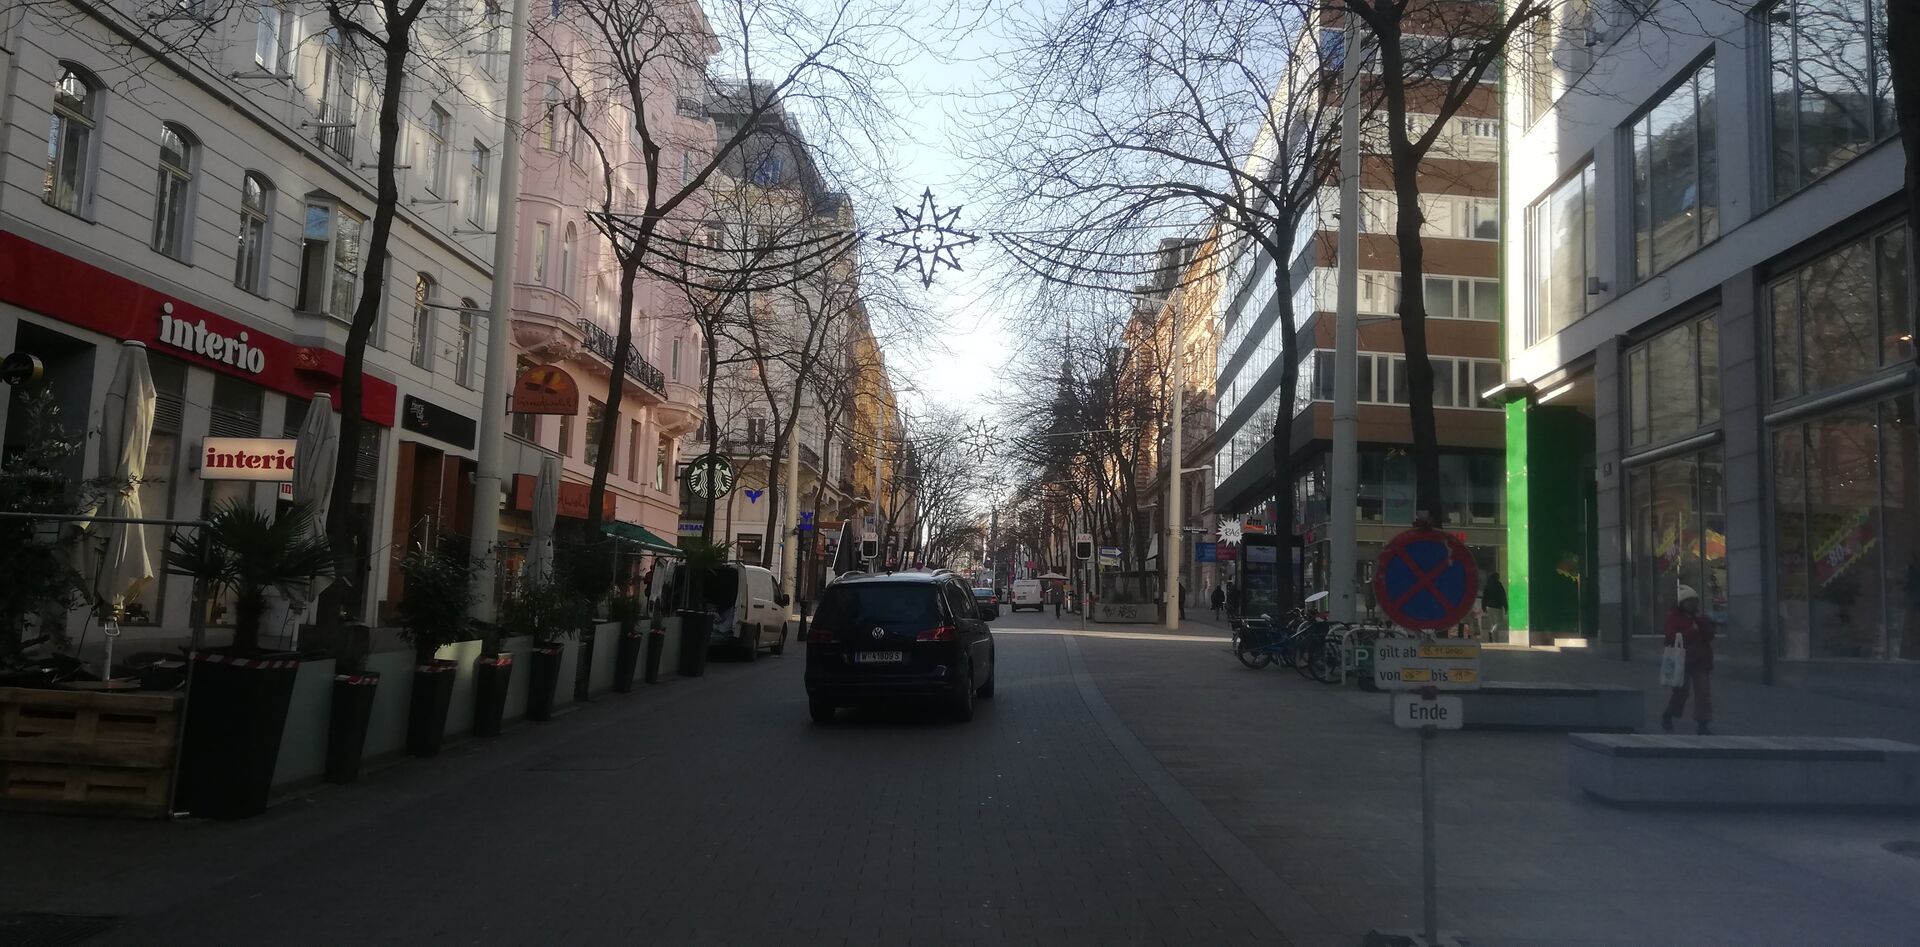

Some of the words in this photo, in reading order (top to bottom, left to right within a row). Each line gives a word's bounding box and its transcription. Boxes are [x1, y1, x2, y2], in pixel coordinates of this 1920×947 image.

[159, 302, 265, 374] interio
[1246, 516, 1263, 526] dm
[1355, 648, 1369, 666] P
[1379, 644, 1401, 661] gilt
[1402, 645, 1417, 658] ab
[1379, 671, 1400, 681] von
[1431, 668, 1448, 681] bis
[1409, 702, 1448, 720] Ende
